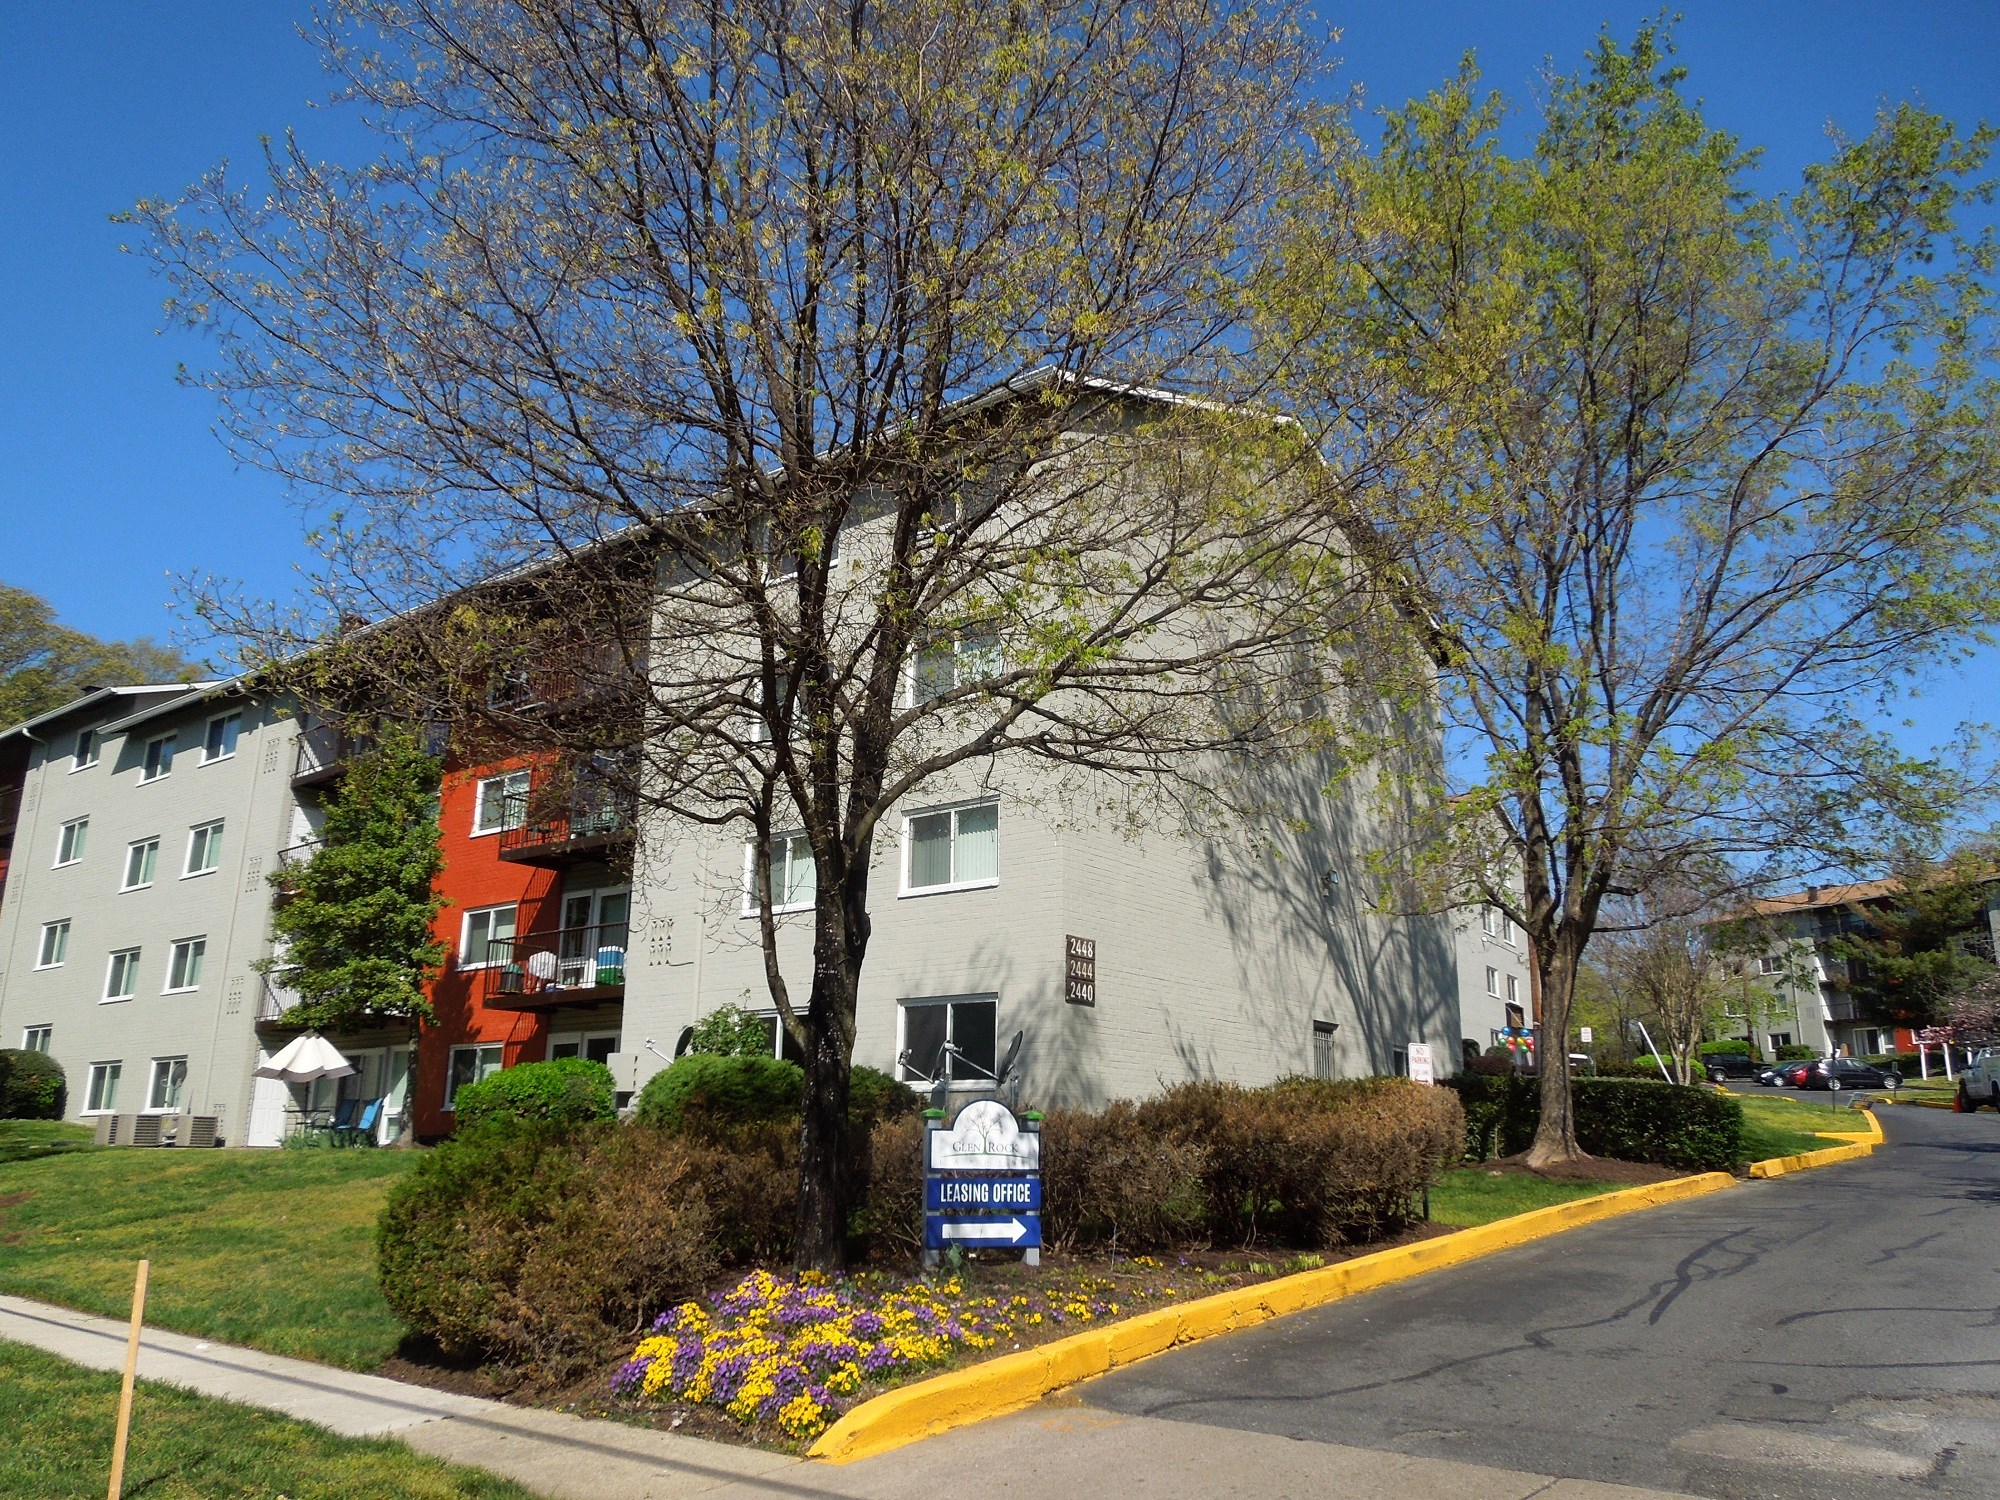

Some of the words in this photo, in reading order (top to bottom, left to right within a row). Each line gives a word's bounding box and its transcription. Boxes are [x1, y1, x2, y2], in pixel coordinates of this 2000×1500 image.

[1070, 938, 1093, 958] 2448
[1070, 960, 1093, 979] 2444
[1070, 981, 1093, 1002] 2440
[952, 1141, 981, 1153] GLEN
[988, 1141, 1018, 1153] ROCK
[940, 1183, 989, 1203] LEASING
[993, 1183, 1031, 1203] OFFICE
